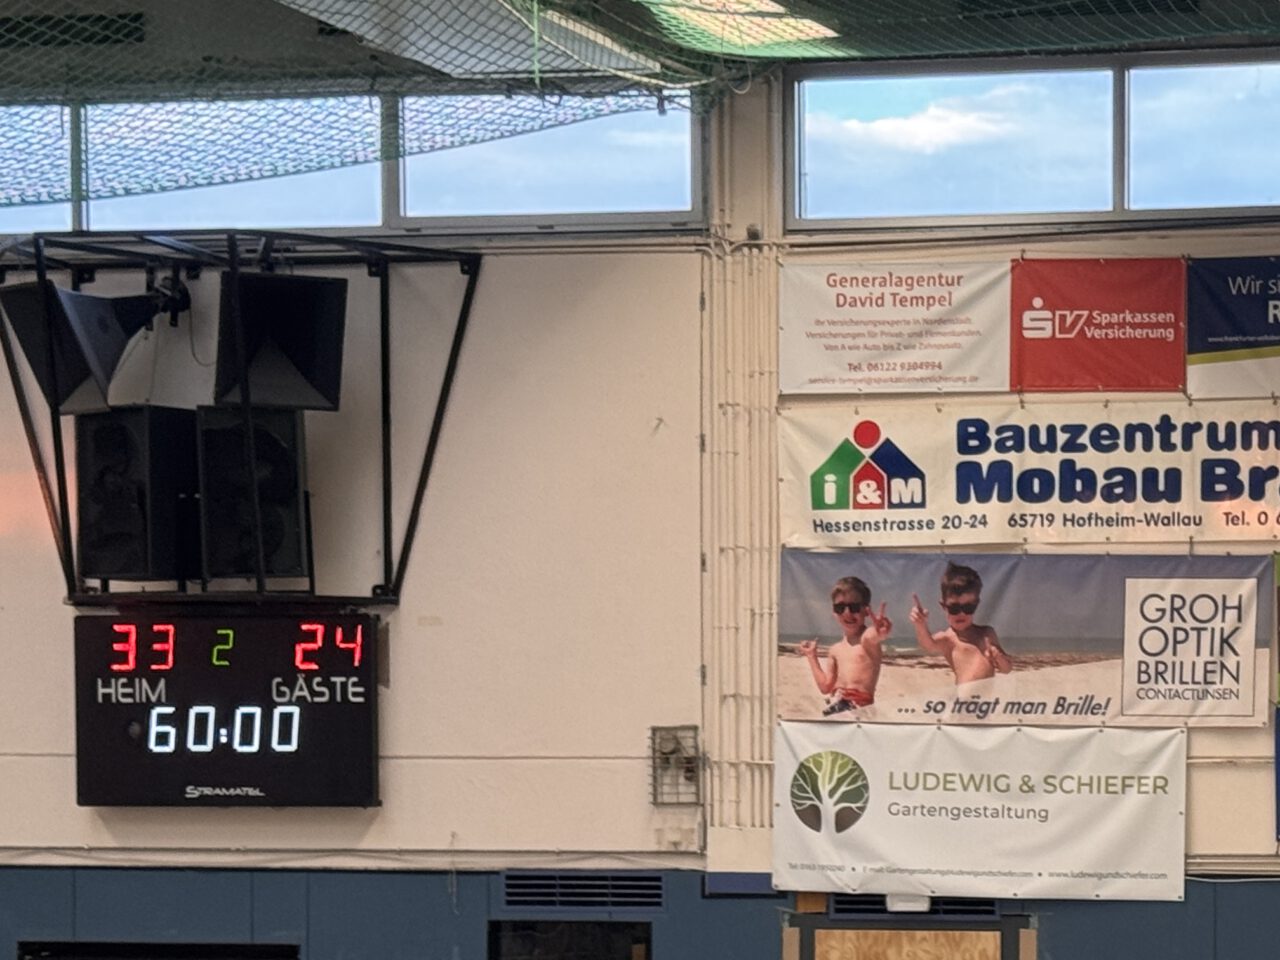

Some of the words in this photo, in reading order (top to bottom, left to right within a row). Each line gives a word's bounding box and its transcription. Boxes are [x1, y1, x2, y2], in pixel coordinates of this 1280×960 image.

[826, 271, 964, 292] Generalagentur
[1228, 276, 1264, 295] Wir
[835, 292, 885, 308] David
[889, 291, 953, 311] Tempel
[1092, 310, 1175, 326] Sparkassen
[1084, 325, 1175, 342] Versicherung
[848, 362, 865, 372] Tel.
[867, 362, 897, 372] 06122
[956, 458, 1182, 504] Mobau
[813, 517, 936, 533] Hessenstrasse
[941, 514, 988, 529] 20-24
[1007, 513, 1056, 528] 65719
[1062, 512, 1203, 528] Hofheim-Wallau
[1222, 511, 1251, 526] Tel.
[1257, 511, 1268, 526] 0
[1139, 593, 1243, 624] GROH
[110, 623, 175, 670] 33
[211, 629, 235, 666] 2
[295, 623, 363, 671] 24
[1138, 626, 1241, 657] OPTIK
[1137, 660, 1240, 685] BRILLEN
[97, 677, 167, 704] HEIM
[271, 673, 365, 702] GÄSTE
[923, 700, 945, 714] so
[951, 694, 1000, 720] trägt
[1002, 699, 1047, 715] man
[1052, 694, 1112, 716] Brille!
[148, 706, 300, 753] 60:00
[185, 785, 265, 798] STRAMATEL
[888, 771, 1011, 793] LUDEWIG
[1019, 774, 1036, 794] &
[1042, 774, 1169, 795] SCHIEFER
[887, 802, 1050, 823] Gartengestaltung
